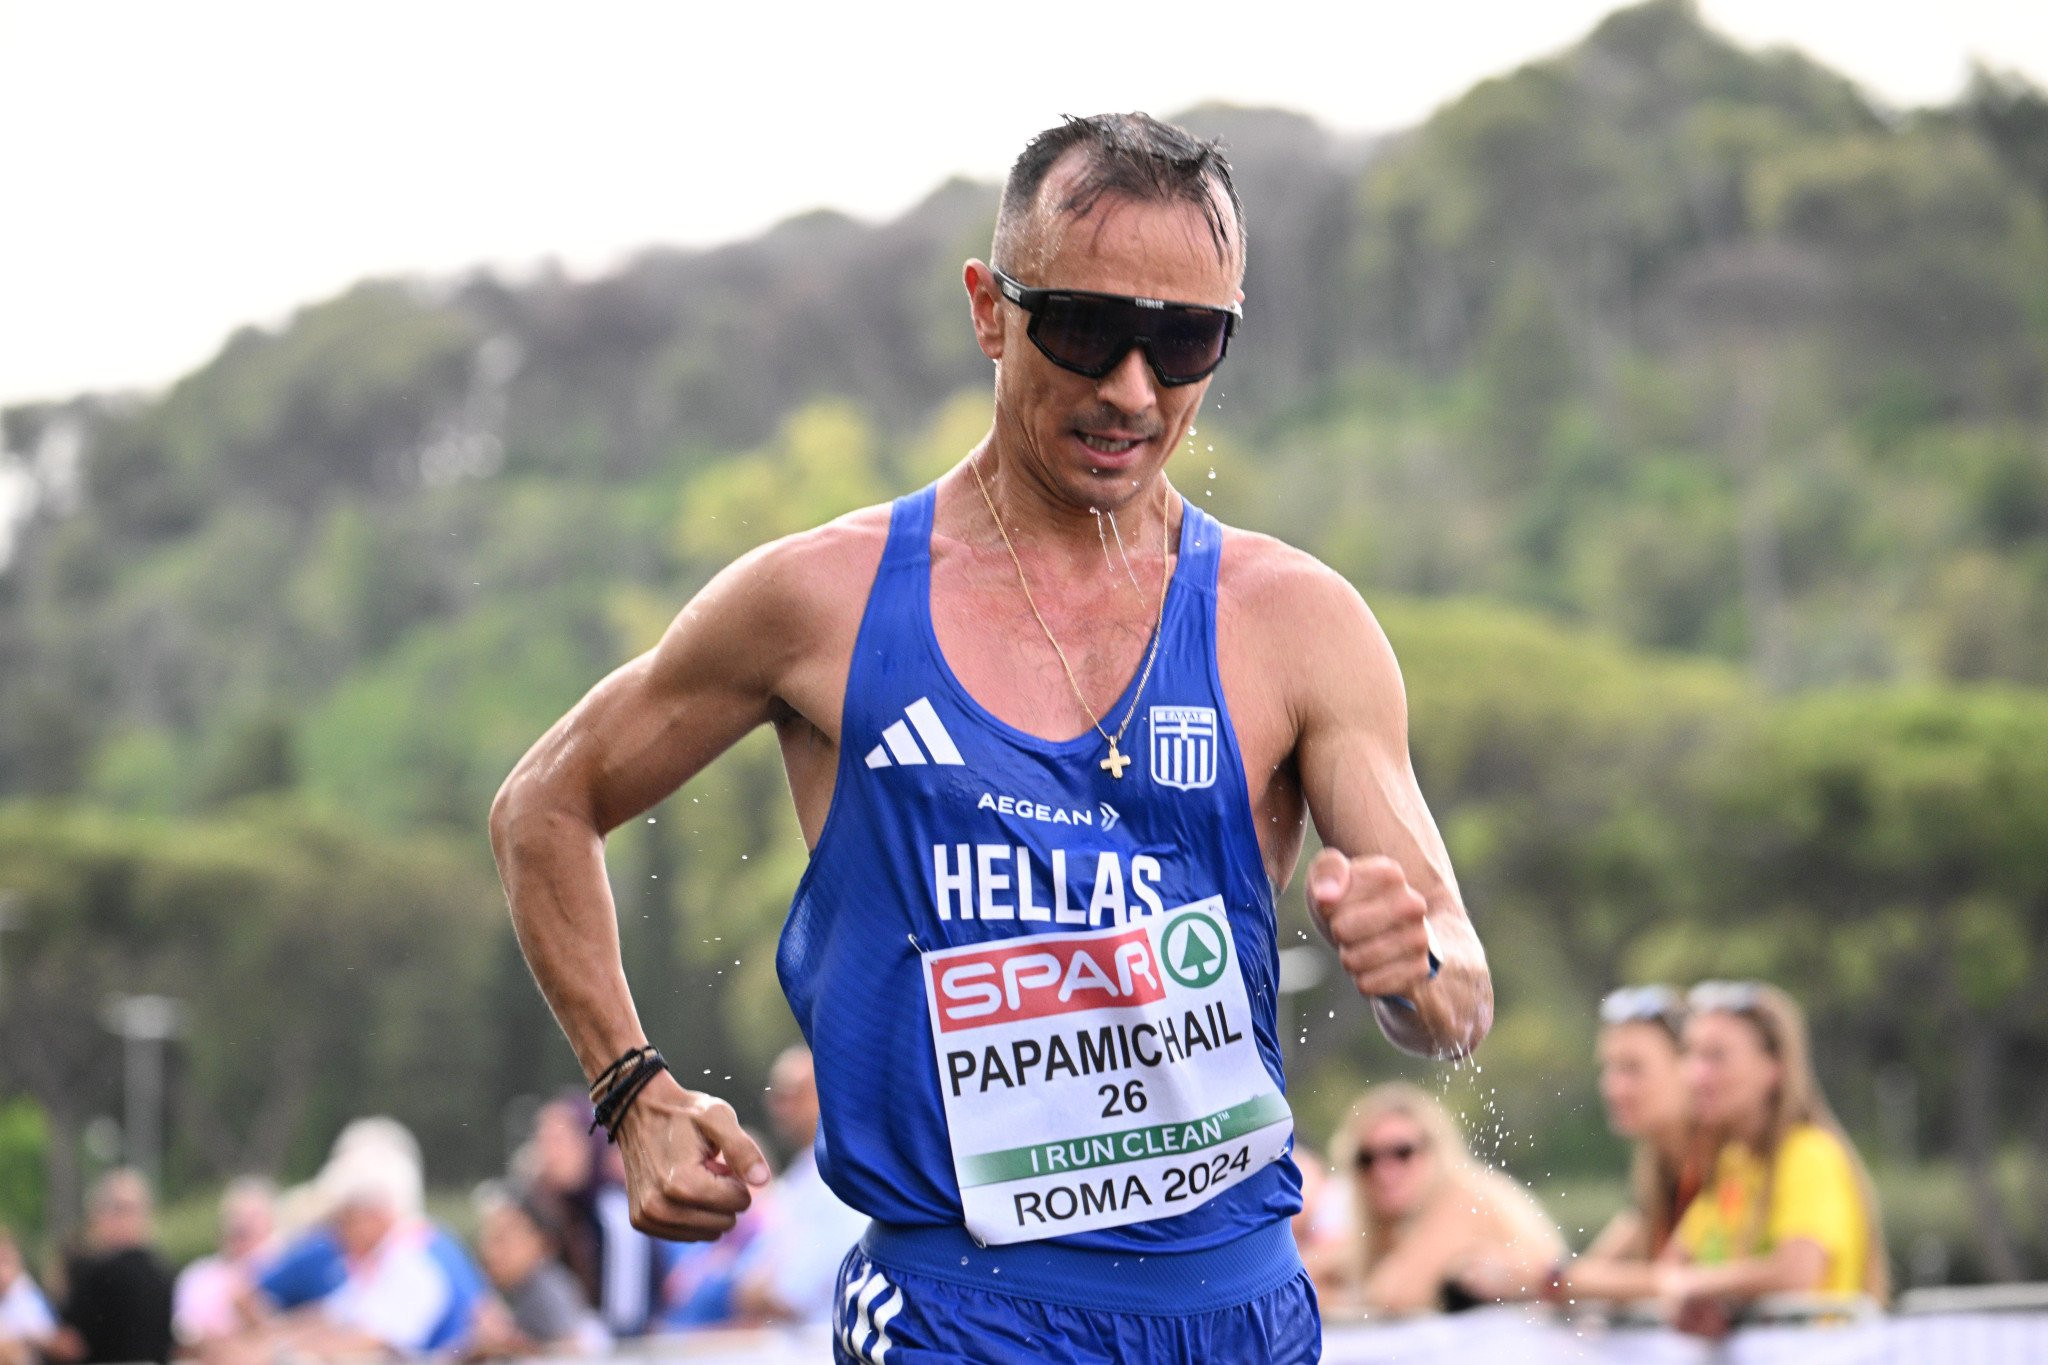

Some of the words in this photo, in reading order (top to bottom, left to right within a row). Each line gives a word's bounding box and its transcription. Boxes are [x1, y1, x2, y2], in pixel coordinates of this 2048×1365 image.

[977, 792, 1093, 826] AEGEAN
[933, 843, 1163, 926] HELLAS
[941, 943, 1158, 1020] SPAR
[947, 1001, 1242, 1097] PAPAMICHAIL
[1098, 1079, 1148, 1118] 26
[1013, 1175, 1152, 1226] ROMA
[1162, 1146, 1250, 1203] 2024
[1031, 1149, 1039, 1172] I
[1046, 1137, 1113, 1169] RUN
